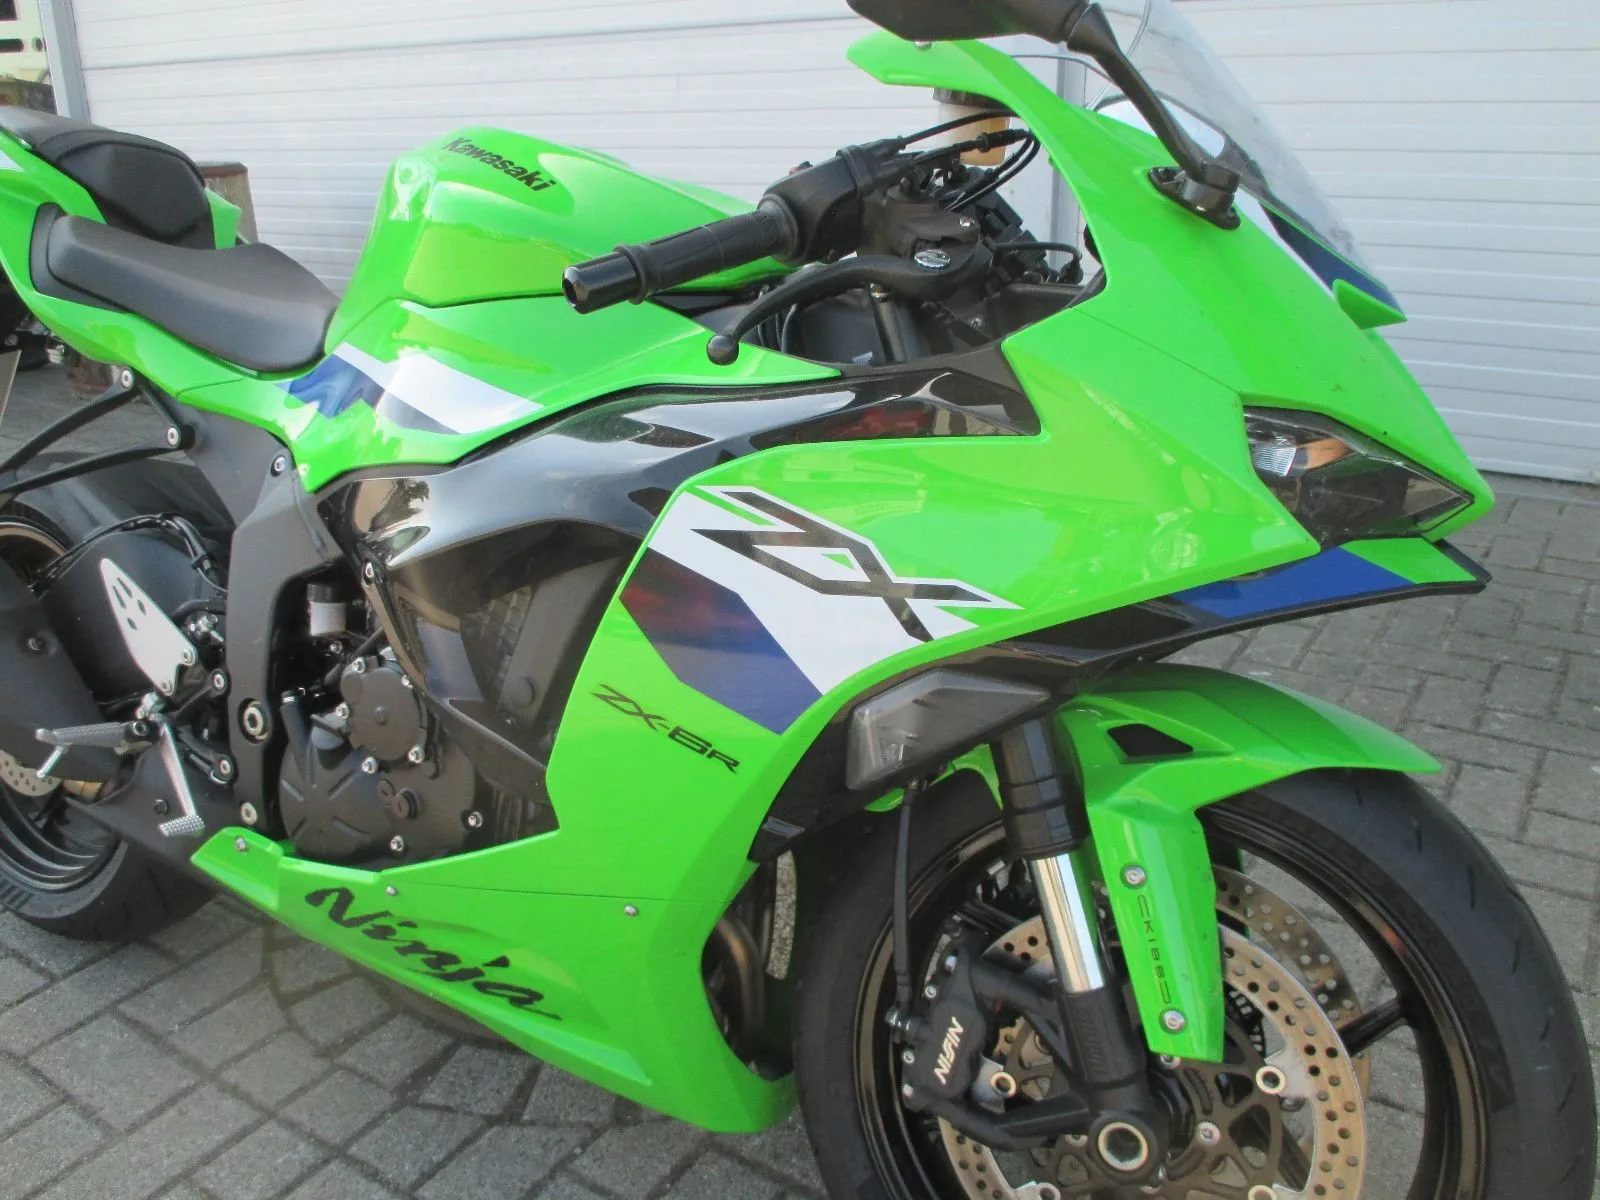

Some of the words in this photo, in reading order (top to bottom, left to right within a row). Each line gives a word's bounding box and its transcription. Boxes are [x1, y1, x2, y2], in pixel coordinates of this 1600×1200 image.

[441, 137, 557, 192] Kawasaki
[591, 682, 740, 774] ZX-6R
[305, 886, 563, 1021] Ninja
[1144, 918, 1165, 978] KIBS
